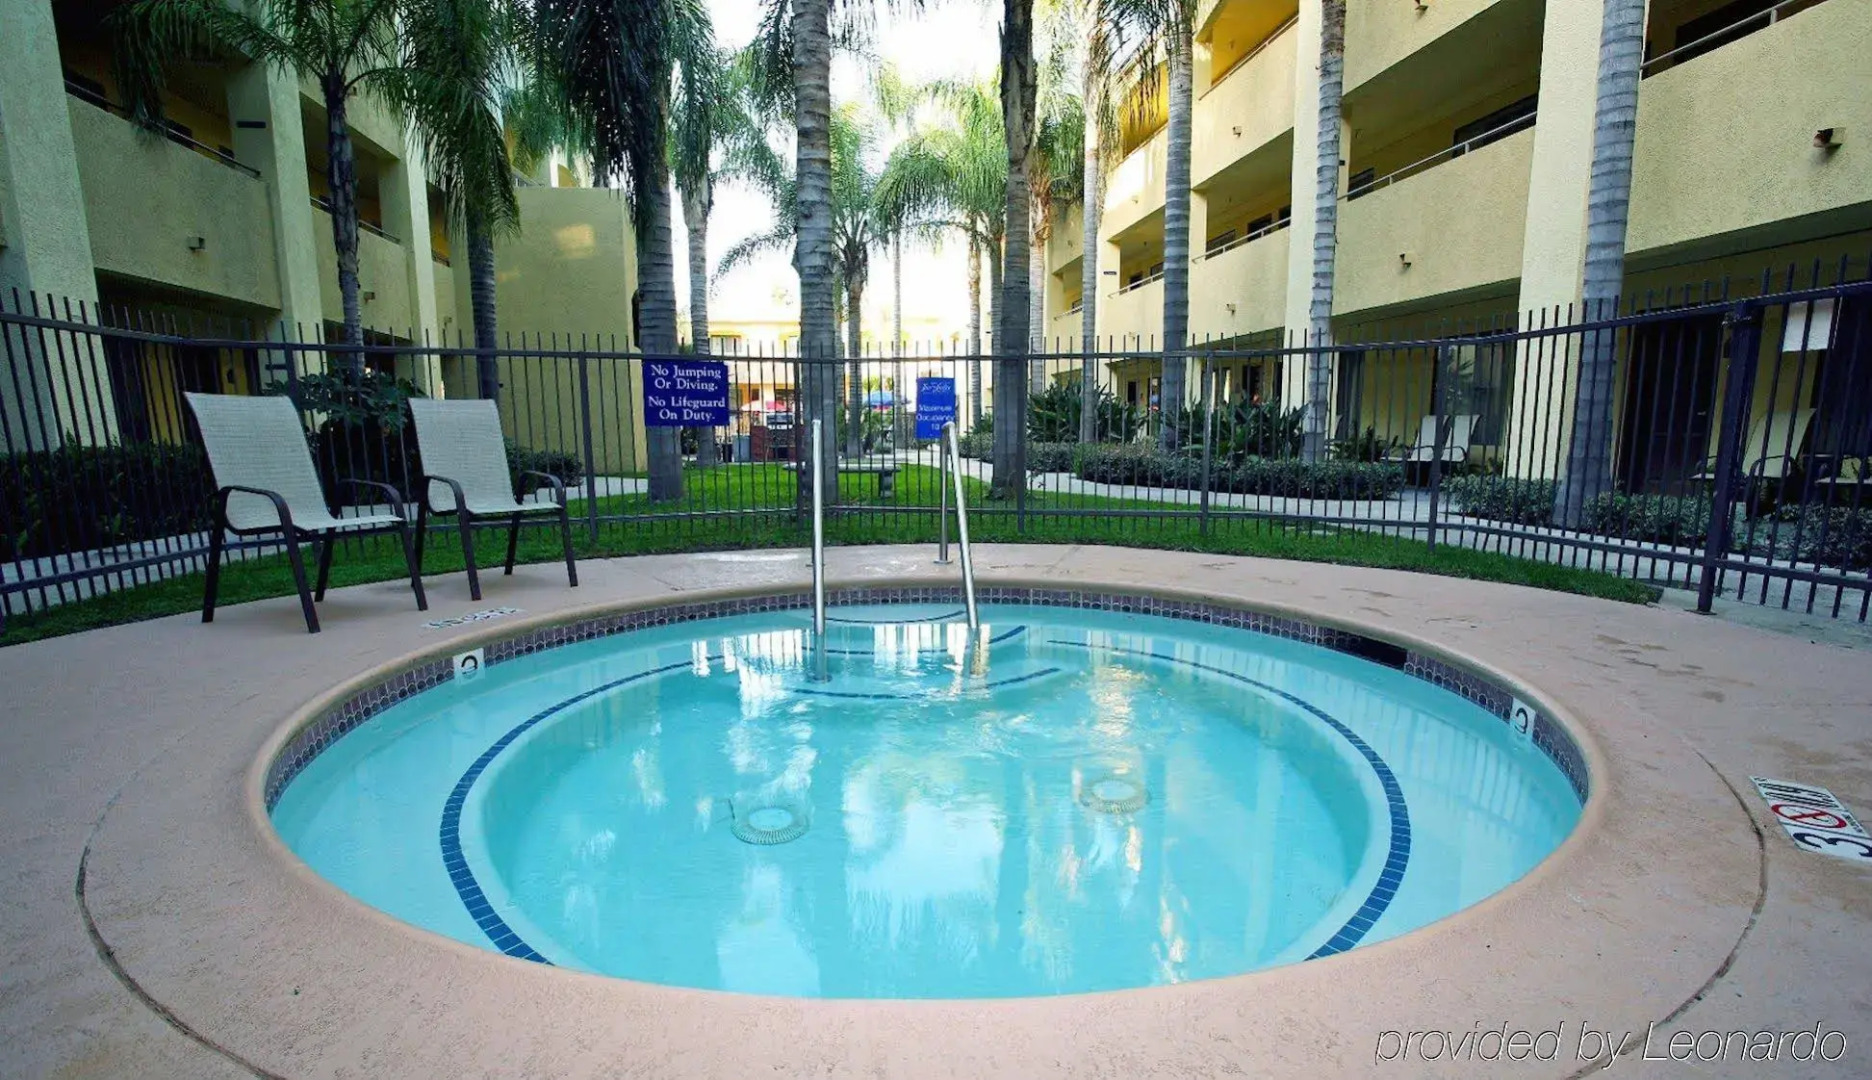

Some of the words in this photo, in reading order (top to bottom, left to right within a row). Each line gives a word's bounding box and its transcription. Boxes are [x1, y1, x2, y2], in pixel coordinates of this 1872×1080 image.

[651, 364, 669, 376] No
[673, 364, 721, 379] Jumping
[654, 377, 671, 389] Or
[676, 377, 718, 392] Diving.
[648, 395, 666, 407] No
[671, 395, 726, 410] Lifeguard
[659, 408, 678, 420] On
[683, 408, 715, 422] Duty.
